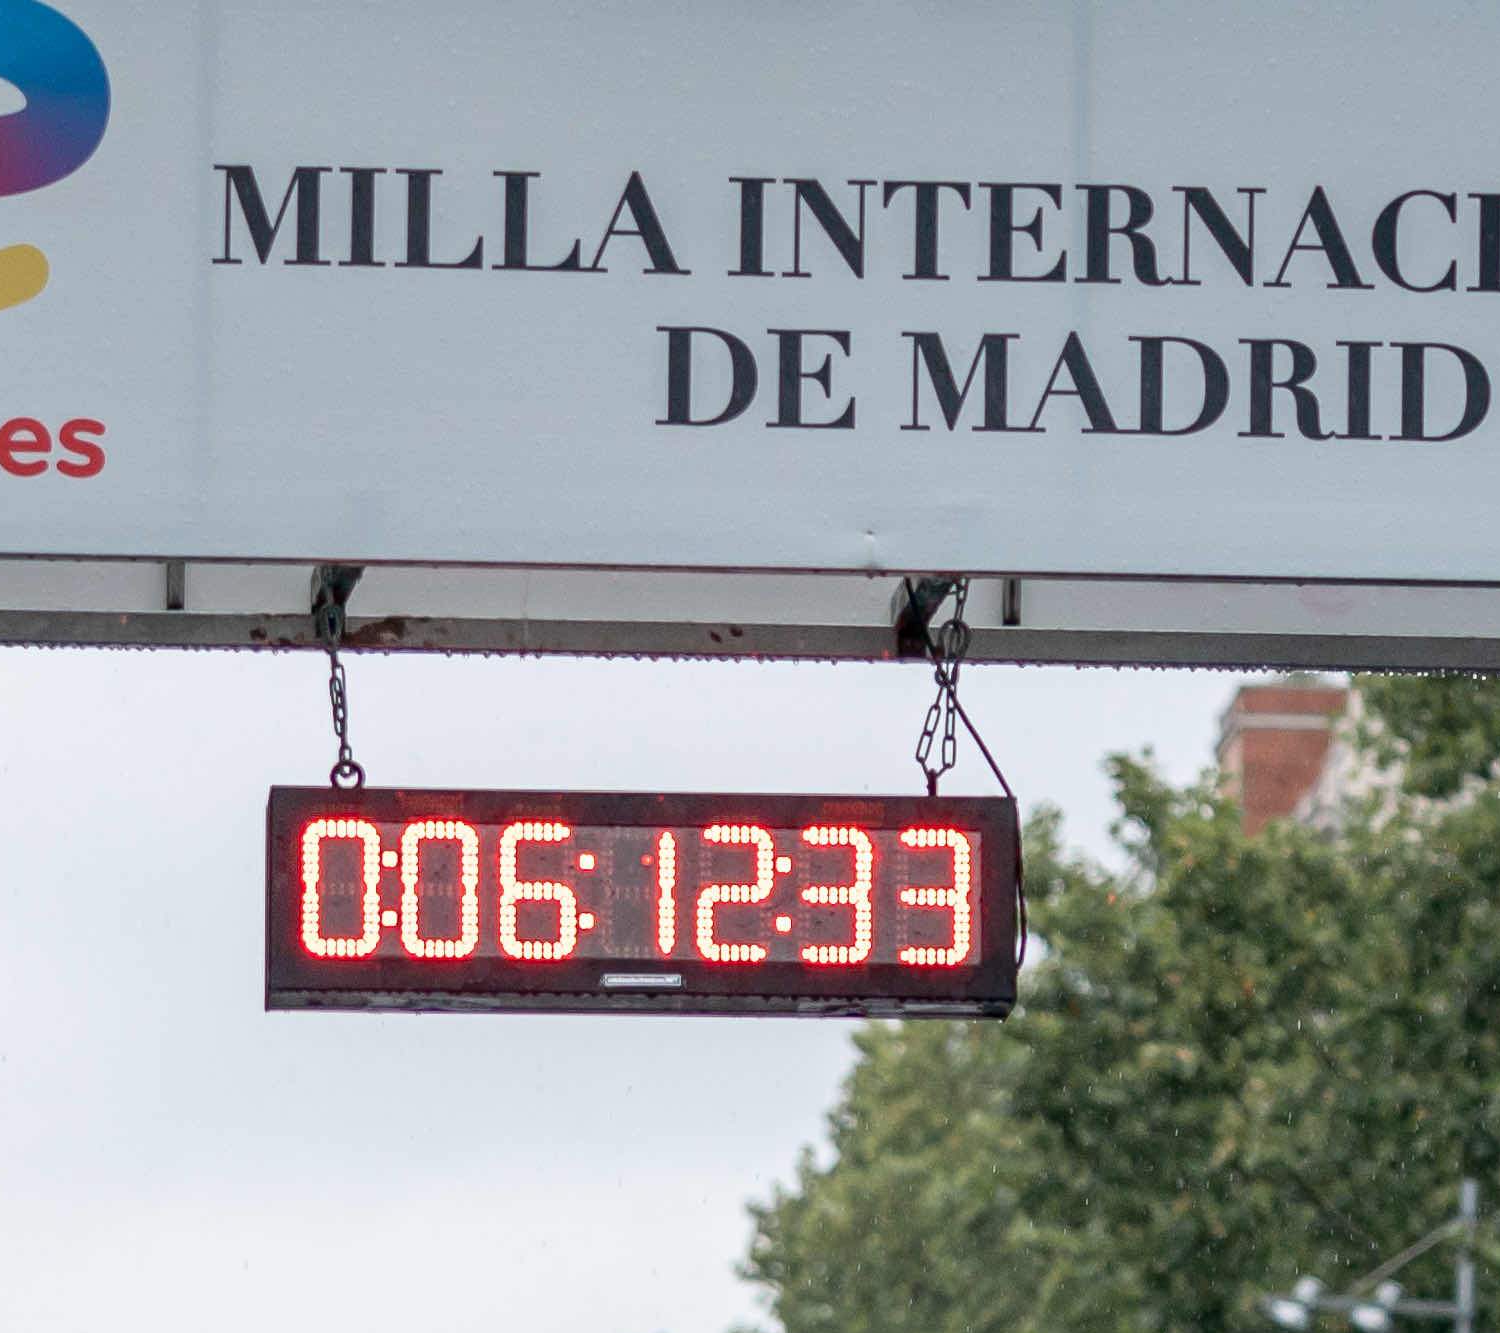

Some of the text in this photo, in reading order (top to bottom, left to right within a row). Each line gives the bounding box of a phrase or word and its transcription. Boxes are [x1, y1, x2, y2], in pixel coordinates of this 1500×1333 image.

[212, 163, 691, 276] MILLA
[655, 325, 1492, 442] DE MADRID
